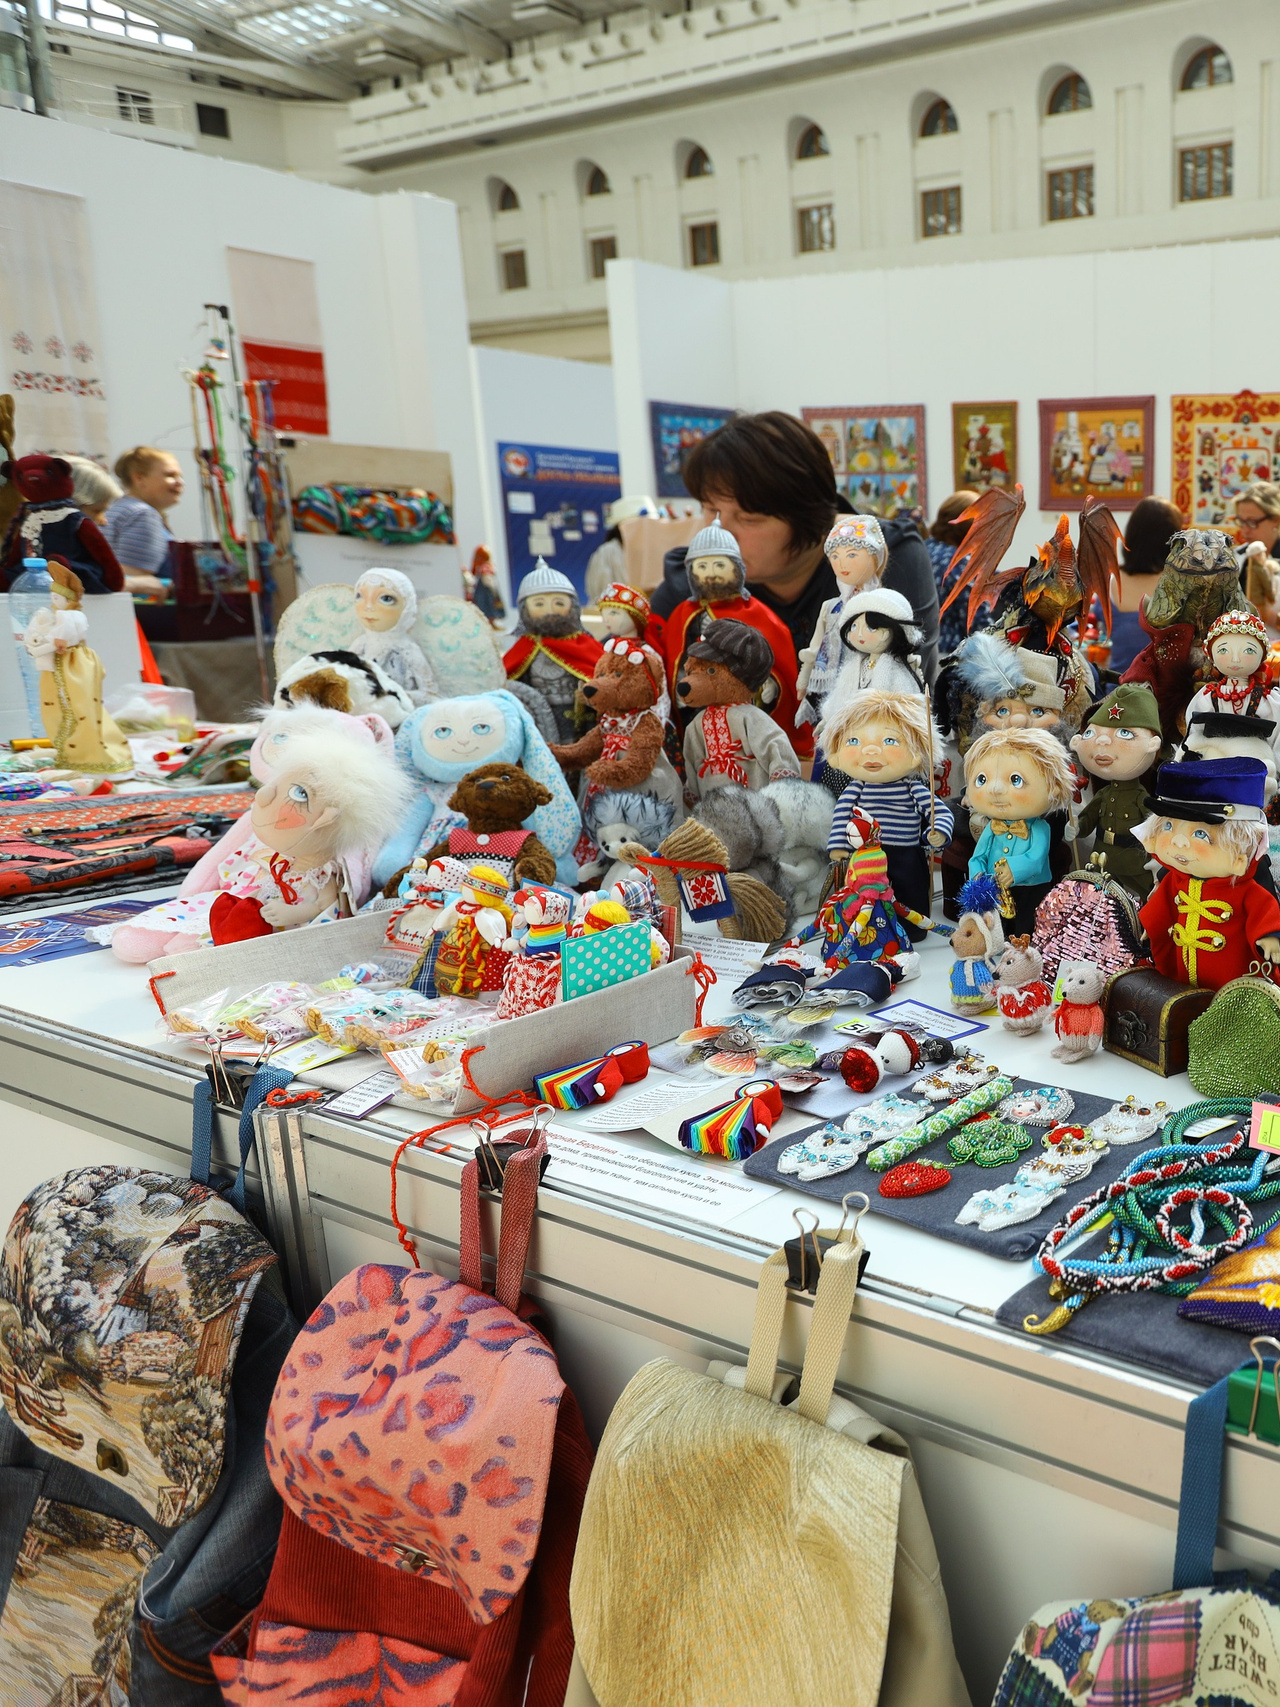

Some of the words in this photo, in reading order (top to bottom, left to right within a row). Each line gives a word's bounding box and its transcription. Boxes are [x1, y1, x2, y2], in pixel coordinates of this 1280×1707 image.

[577, 1140, 618, 1155] Берегиня
[1239, 1613, 1260, 1638] club
[1224, 1633, 1267, 1674] BEAR
[1208, 1653, 1278, 1697] SWEET
